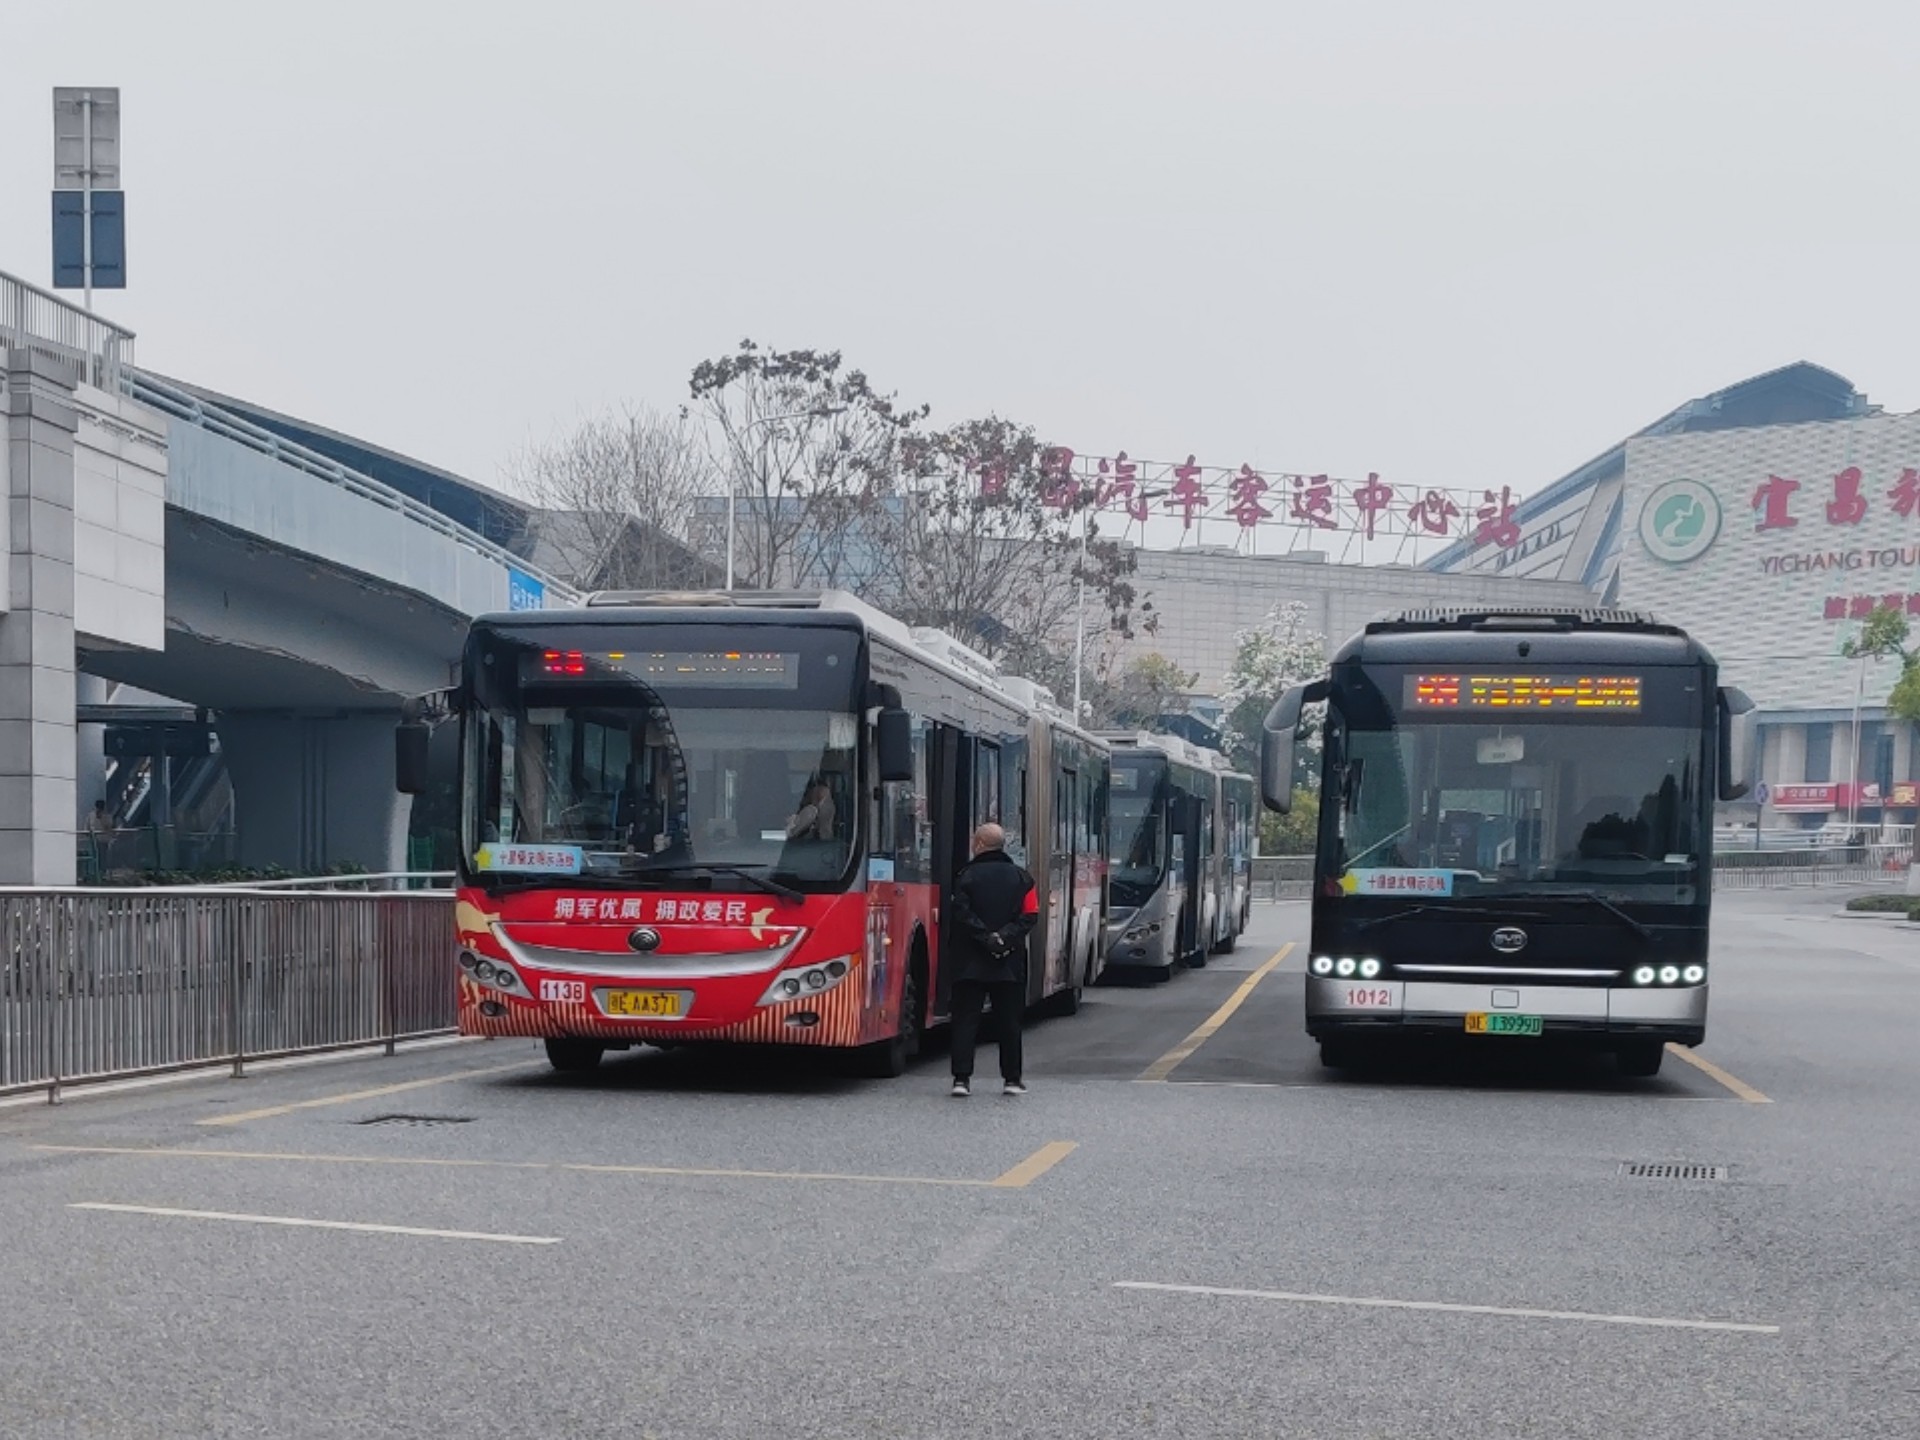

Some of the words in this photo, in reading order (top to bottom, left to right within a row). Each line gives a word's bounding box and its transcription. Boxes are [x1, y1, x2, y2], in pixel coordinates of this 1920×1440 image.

[1760, 552, 1862, 574] YICHANG
[1865, 547, 1920, 569] TOU
[554, 898, 643, 919] 拥军优属
[655, 899, 747, 921] 拥政爱民
[542, 982, 584, 1001] 1138
[1347, 989, 1389, 1006] 1012
